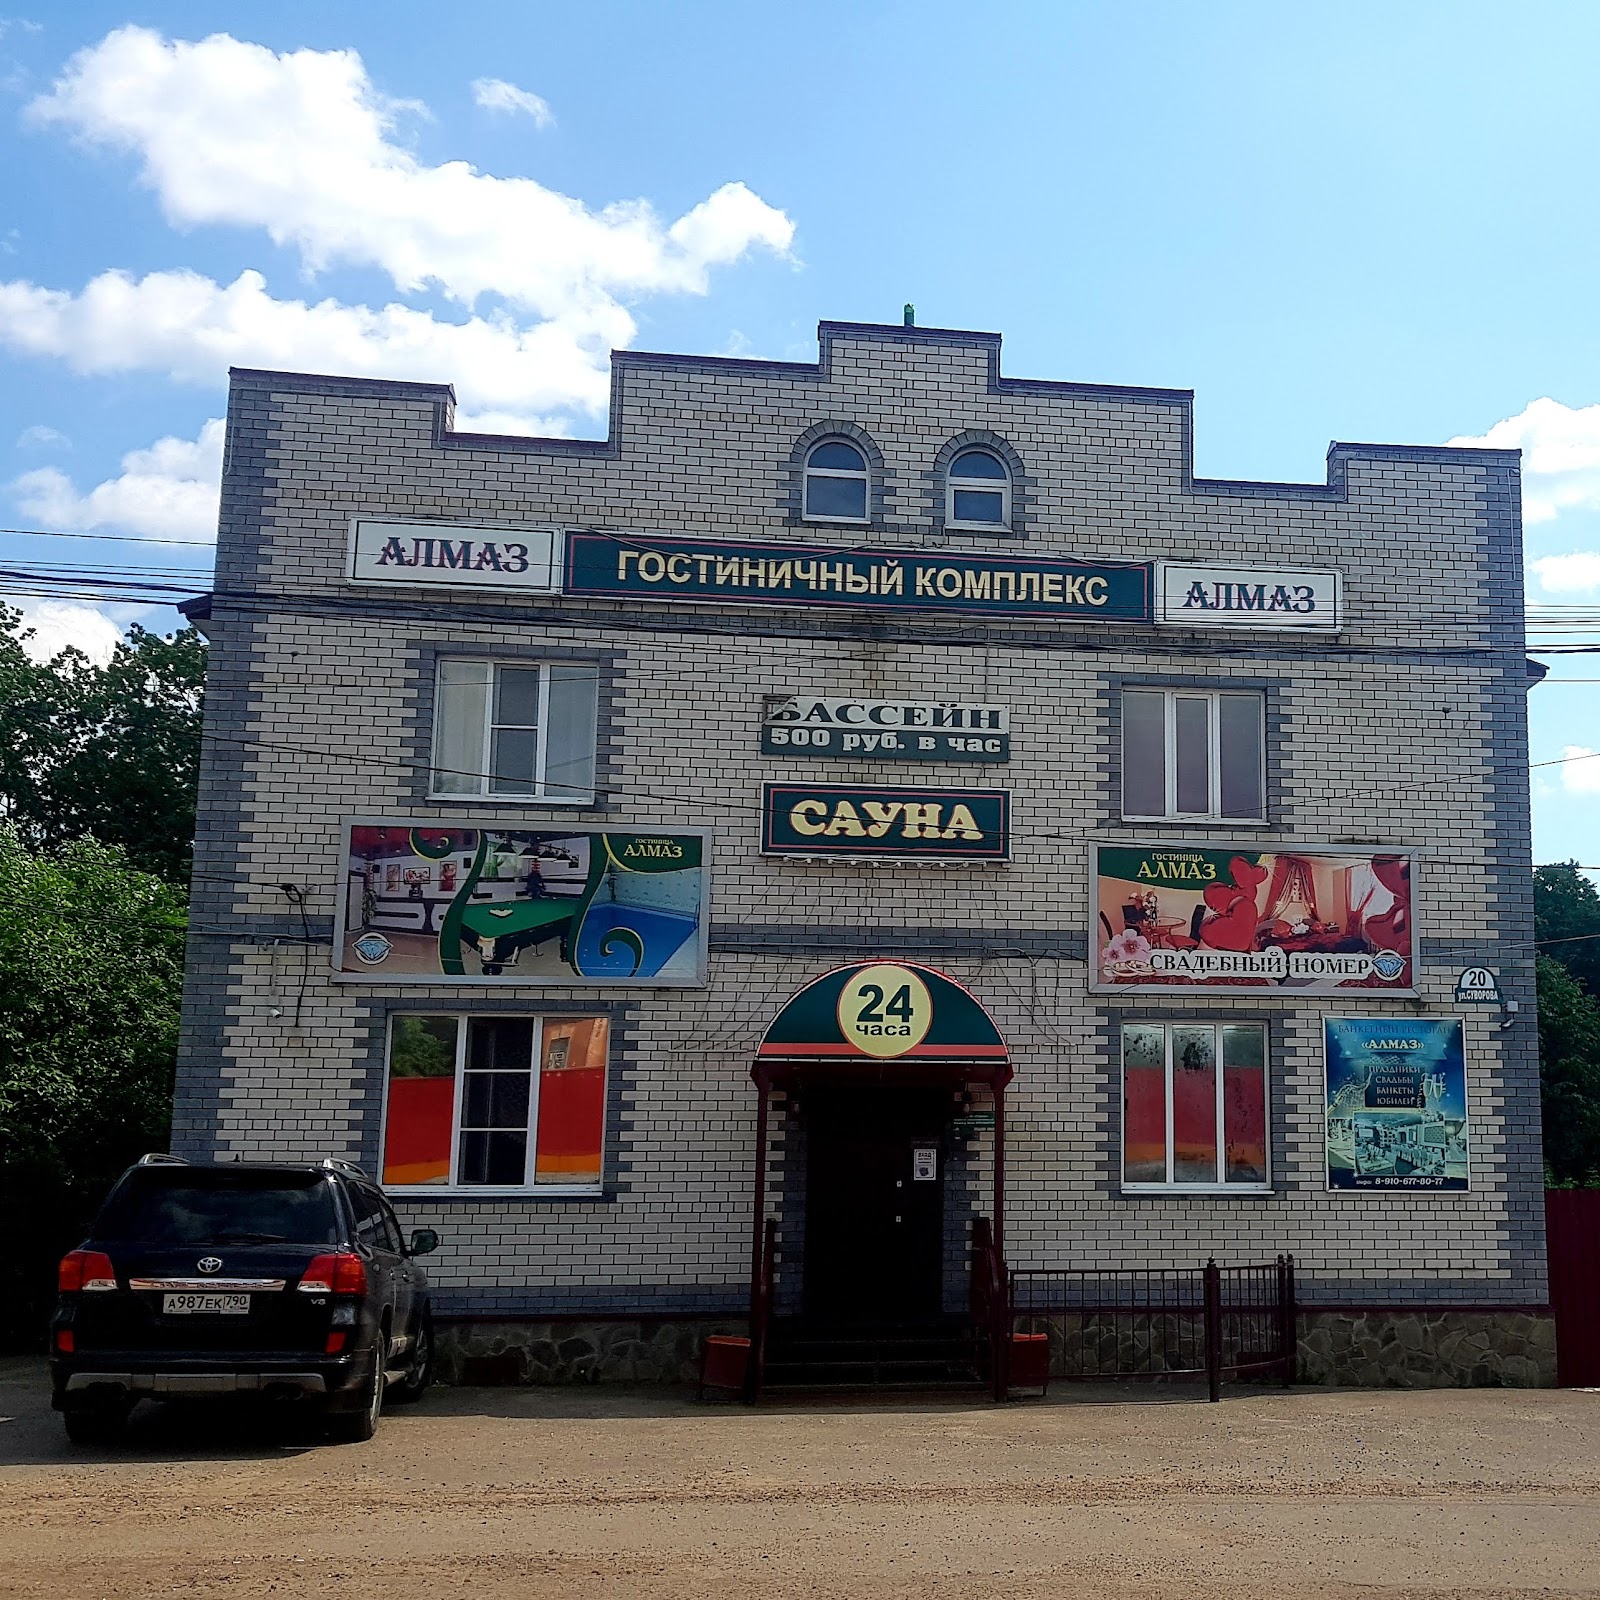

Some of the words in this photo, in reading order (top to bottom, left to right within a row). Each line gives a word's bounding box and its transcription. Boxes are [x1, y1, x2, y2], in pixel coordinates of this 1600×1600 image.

[375, 536, 529, 573] АЛМАЗ
[617, 549, 904, 595] ГОСТИНИЧНЫЙ
[914, 566, 1109, 607] КОМПЛЕКС
[1182, 581, 1316, 614] АЛМАЗ
[769, 701, 1002, 729] БАССЕЙН
[770, 728, 832, 746] 500
[842, 732, 905, 752] руб.
[918, 735, 937, 750] в
[947, 736, 1001, 753] час
[789, 799, 985, 840] САУНА
[623, 844, 683, 858] АЛМАЗ
[1151, 852, 1204, 863] ГОСТИНИЦА
[1136, 861, 1217, 880] АЛМАЗ
[1149, 951, 1282, 974] СВАДЕБНЫЙ
[1294, 957, 1369, 978] НОМЕР
[1469, 971, 1486, 986] 20
[857, 984, 913, 1023] 24
[855, 1024, 911, 1036] часа
[1361, 1039, 1425, 1050] «АЛМАЗ»
[1369, 1066, 1420, 1074] ПРАЗДНИКИ
[1375, 1076, 1414, 1084] СВАДЬБЫ
[1376, 1086, 1414, 1095] БАНКЕТЫ
[1375, 1177, 1444, 1186] 8-910-677-80-77
